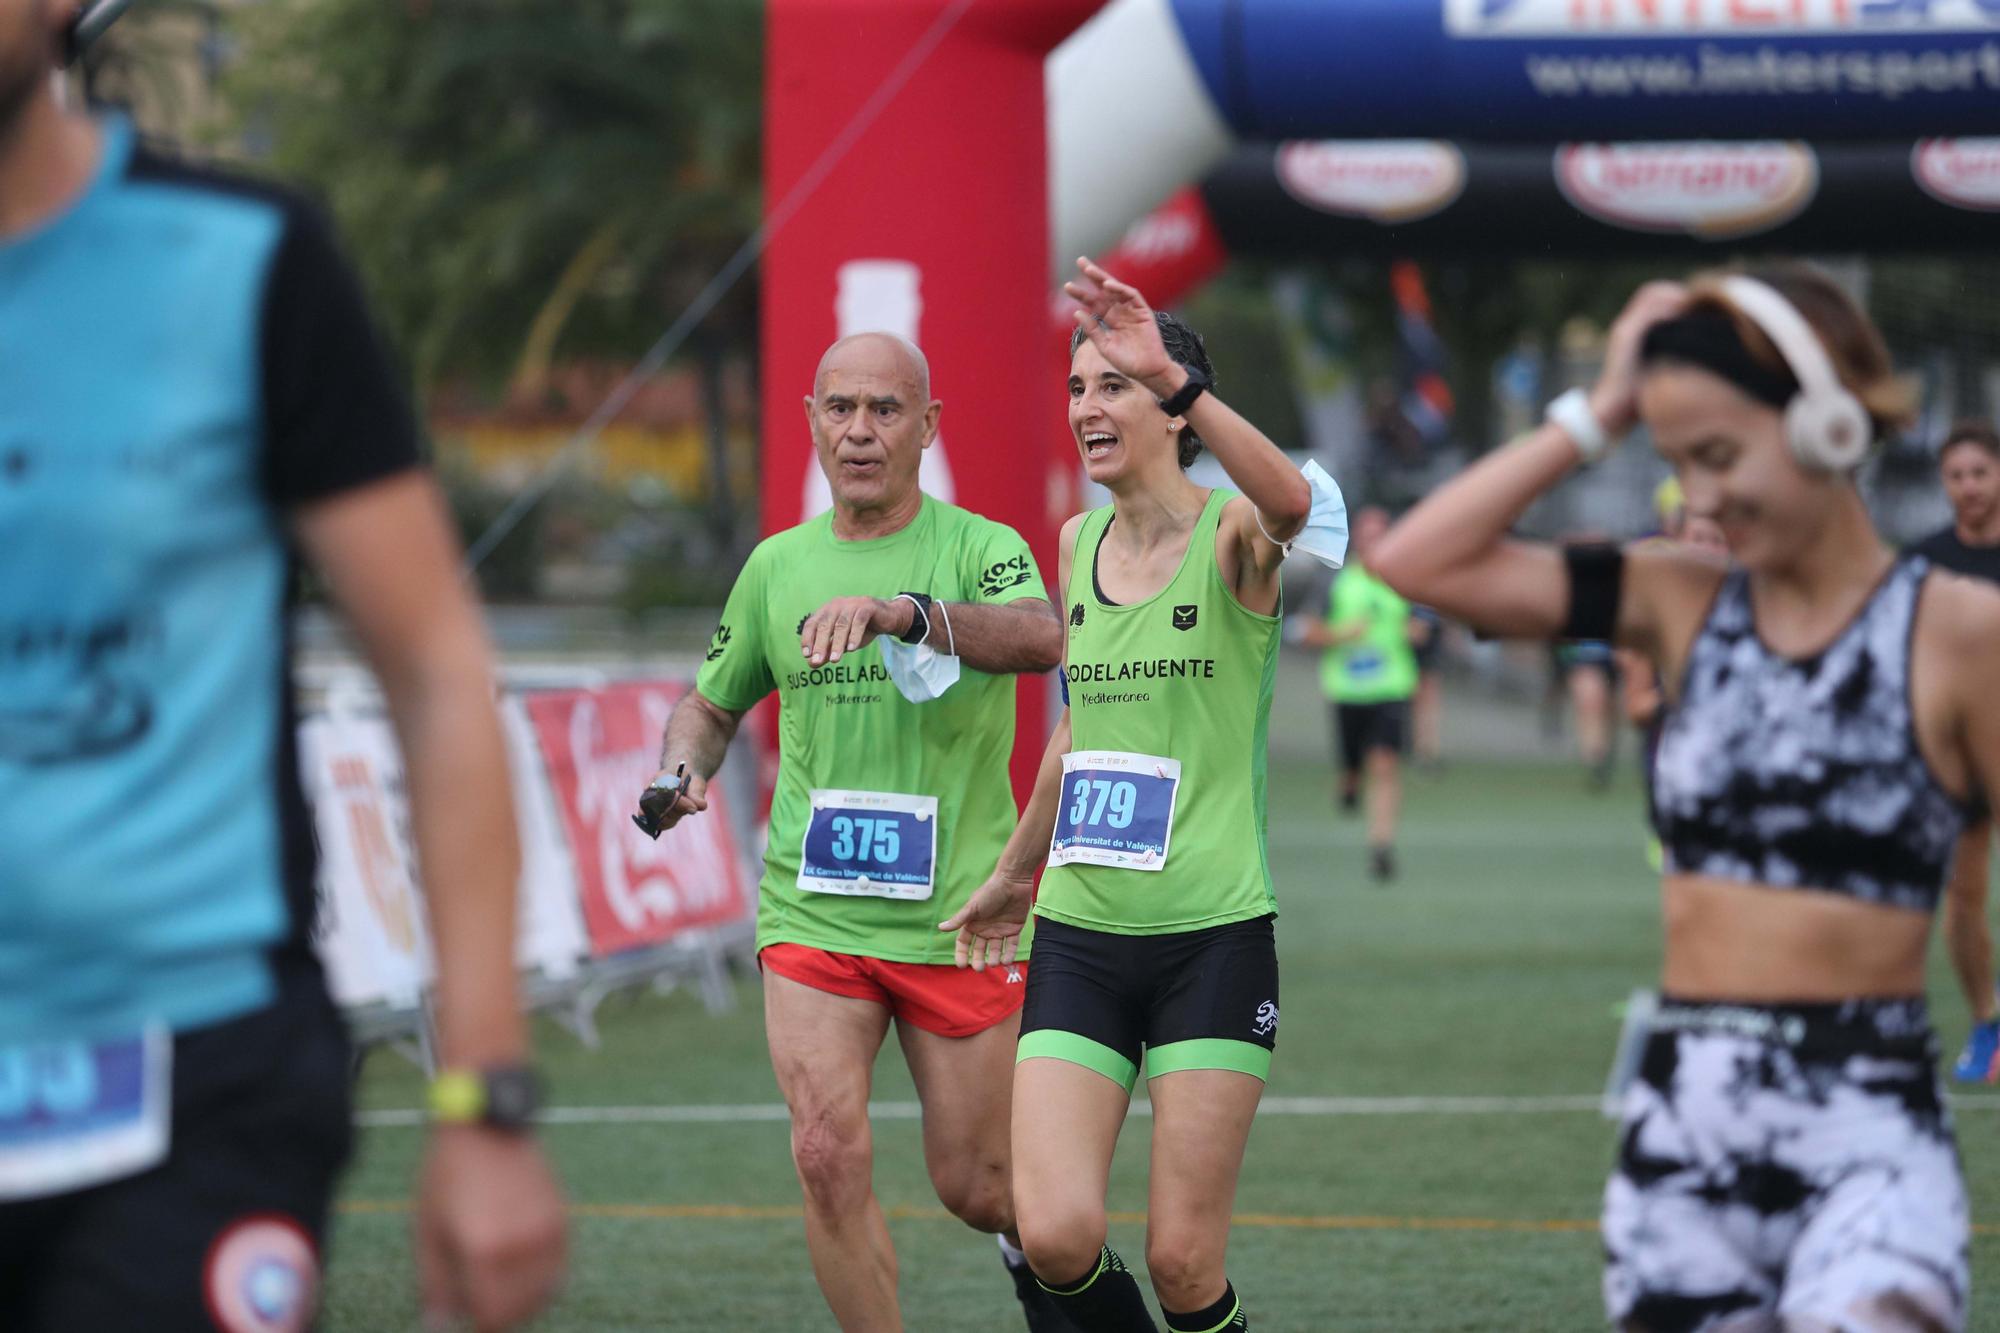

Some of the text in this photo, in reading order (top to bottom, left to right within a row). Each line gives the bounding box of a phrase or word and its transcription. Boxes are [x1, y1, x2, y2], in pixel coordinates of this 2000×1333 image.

[787, 664, 892, 690] SUSODELAFU
[1070, 779, 1137, 829] 379
[831, 816, 900, 863] 375
[1072, 835, 1112, 847] Universitat
[1112, 839, 1124, 848] de
[883, 872, 894, 881] de
